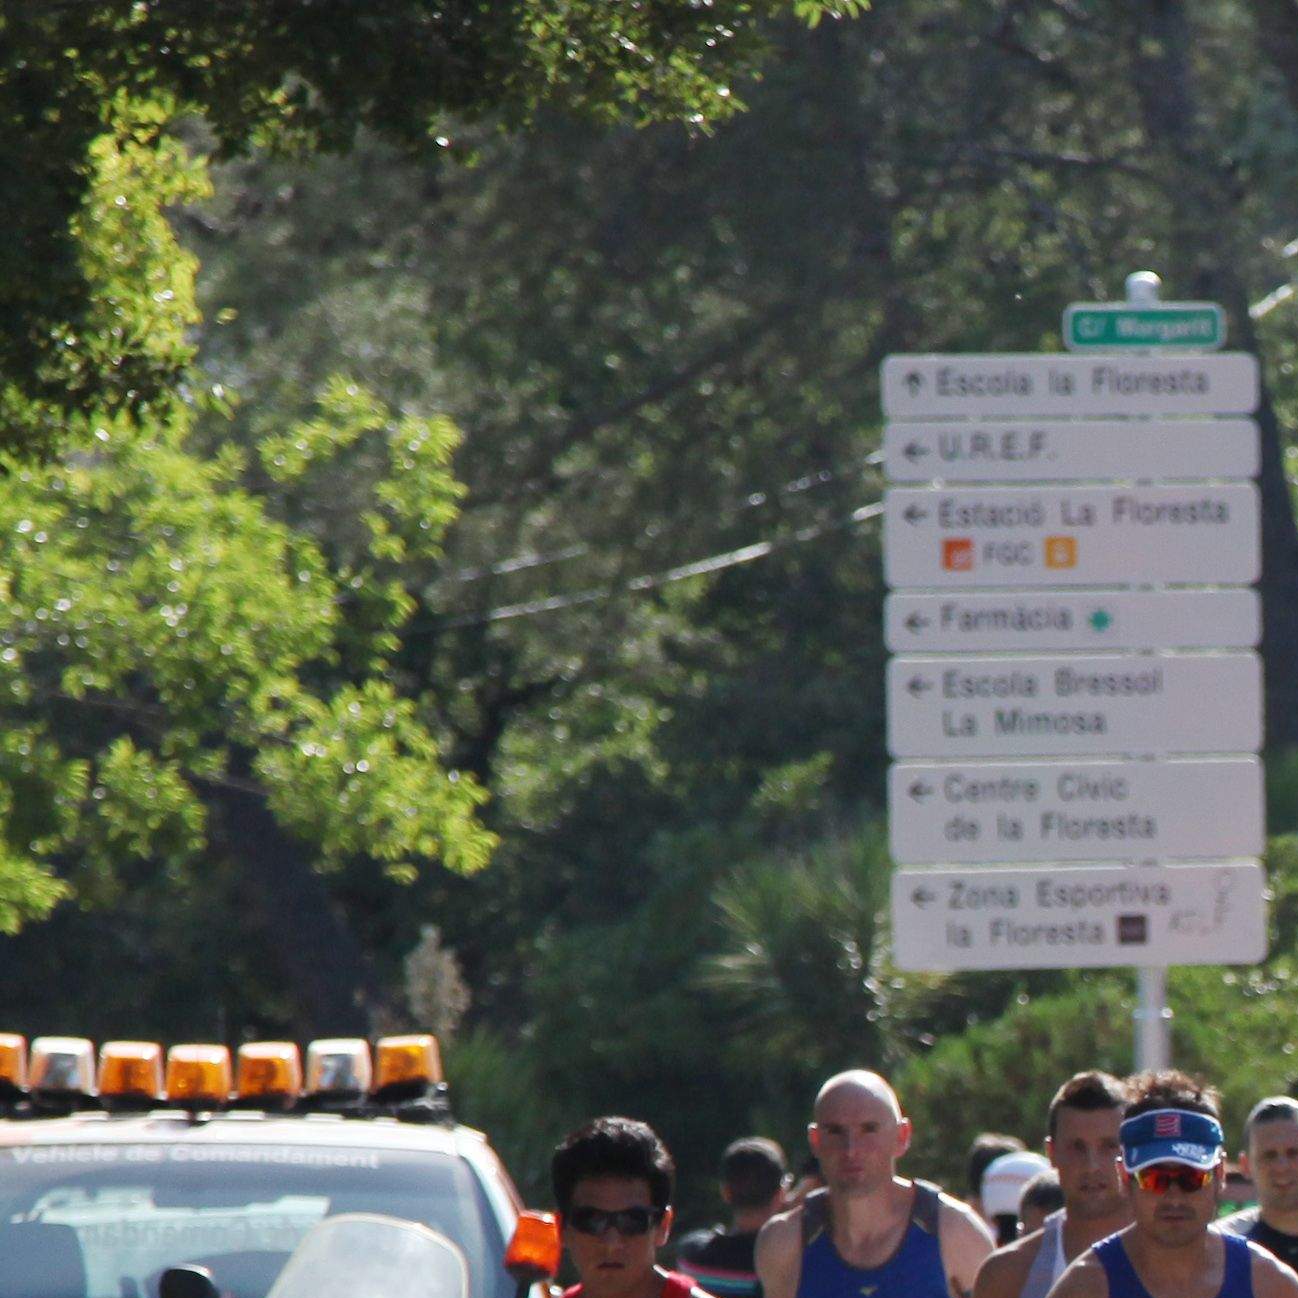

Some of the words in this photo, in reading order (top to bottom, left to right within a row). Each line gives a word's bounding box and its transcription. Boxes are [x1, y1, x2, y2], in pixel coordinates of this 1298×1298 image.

[935, 366, 1033, 397] Escola
[1049, 368, 1076, 396] la
[1091, 365, 1210, 396] Floresta
[937, 499, 1047, 528] Estació
[1061, 500, 1098, 527] La
[1112, 496, 1231, 525] Floresta
[982, 539, 1035, 567] FGC
[942, 669, 1040, 698] Escola
[1054, 667, 1164, 697] Bressol
[942, 709, 979, 738] La
[994, 708, 1108, 736] Mimosa
[944, 773, 1040, 802] Centre
[944, 814, 981, 842] de
[996, 813, 1024, 841] la
[1040, 811, 1157, 840] Floresta
[947, 880, 1020, 910] Zona
[1036, 878, 1172, 908] Esportiva
[945, 921, 973, 949] la
[989, 917, 1106, 947] Floresta
